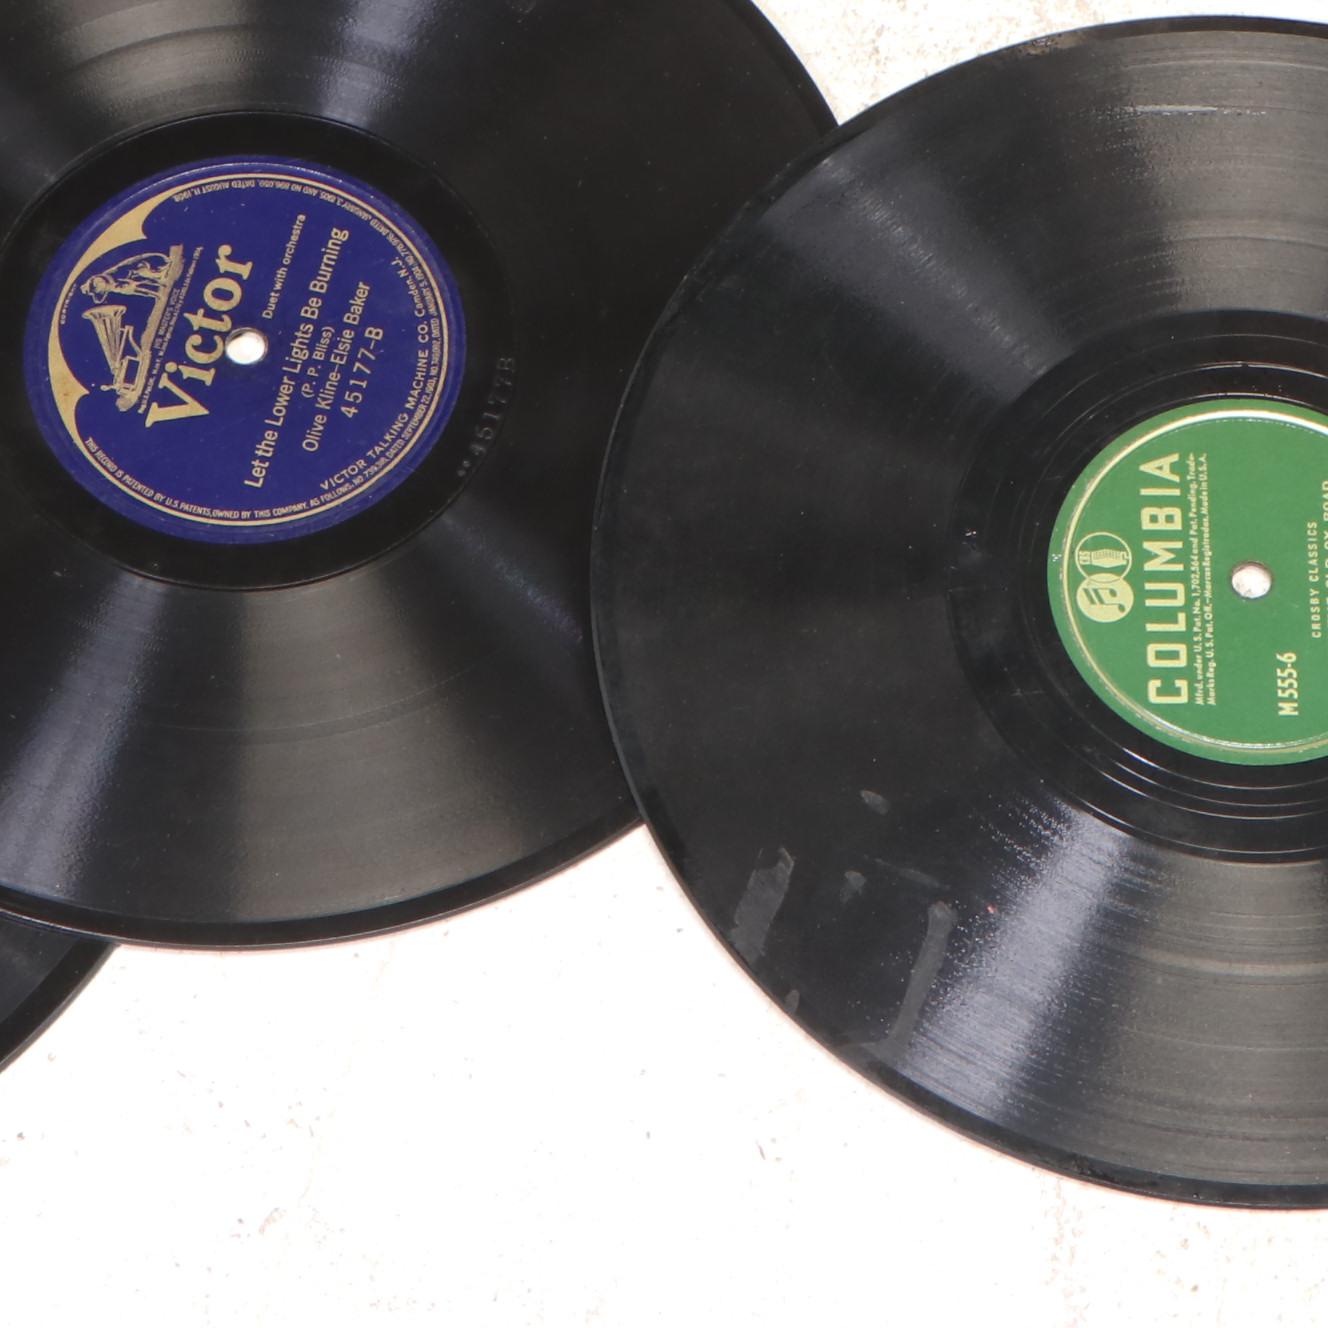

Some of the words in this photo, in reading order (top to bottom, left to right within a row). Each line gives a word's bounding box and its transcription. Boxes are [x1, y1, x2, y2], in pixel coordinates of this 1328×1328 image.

[262, 290, 279, 319] Duet
[272, 267, 289, 292] with
[282, 213, 307, 265] orchestra
[309, 227, 350, 294] Burning
[300, 297, 323, 320] Be
[416, 320, 429, 343] CO.
[144, 244, 254, 428] Victor
[282, 323, 314, 374] Lights
[301, 381, 317, 398] (P.
[312, 326, 336, 361] Bliss)
[302, 413, 328, 452] Olive
[343, 281, 371, 325] Baker
[404, 349, 429, 409] MACHINE
[264, 375, 296, 427] Lower
[254, 429, 279, 458] the
[366, 412, 409, 458] TALKING
[243, 459, 270, 489] Let
[320, 458, 368, 491] VICTOR
[1307, 521, 1320, 582] CLASSICS
[1139, 453, 1188, 704] COLUMBIA
[1309, 588, 1321, 638] CROSBY
